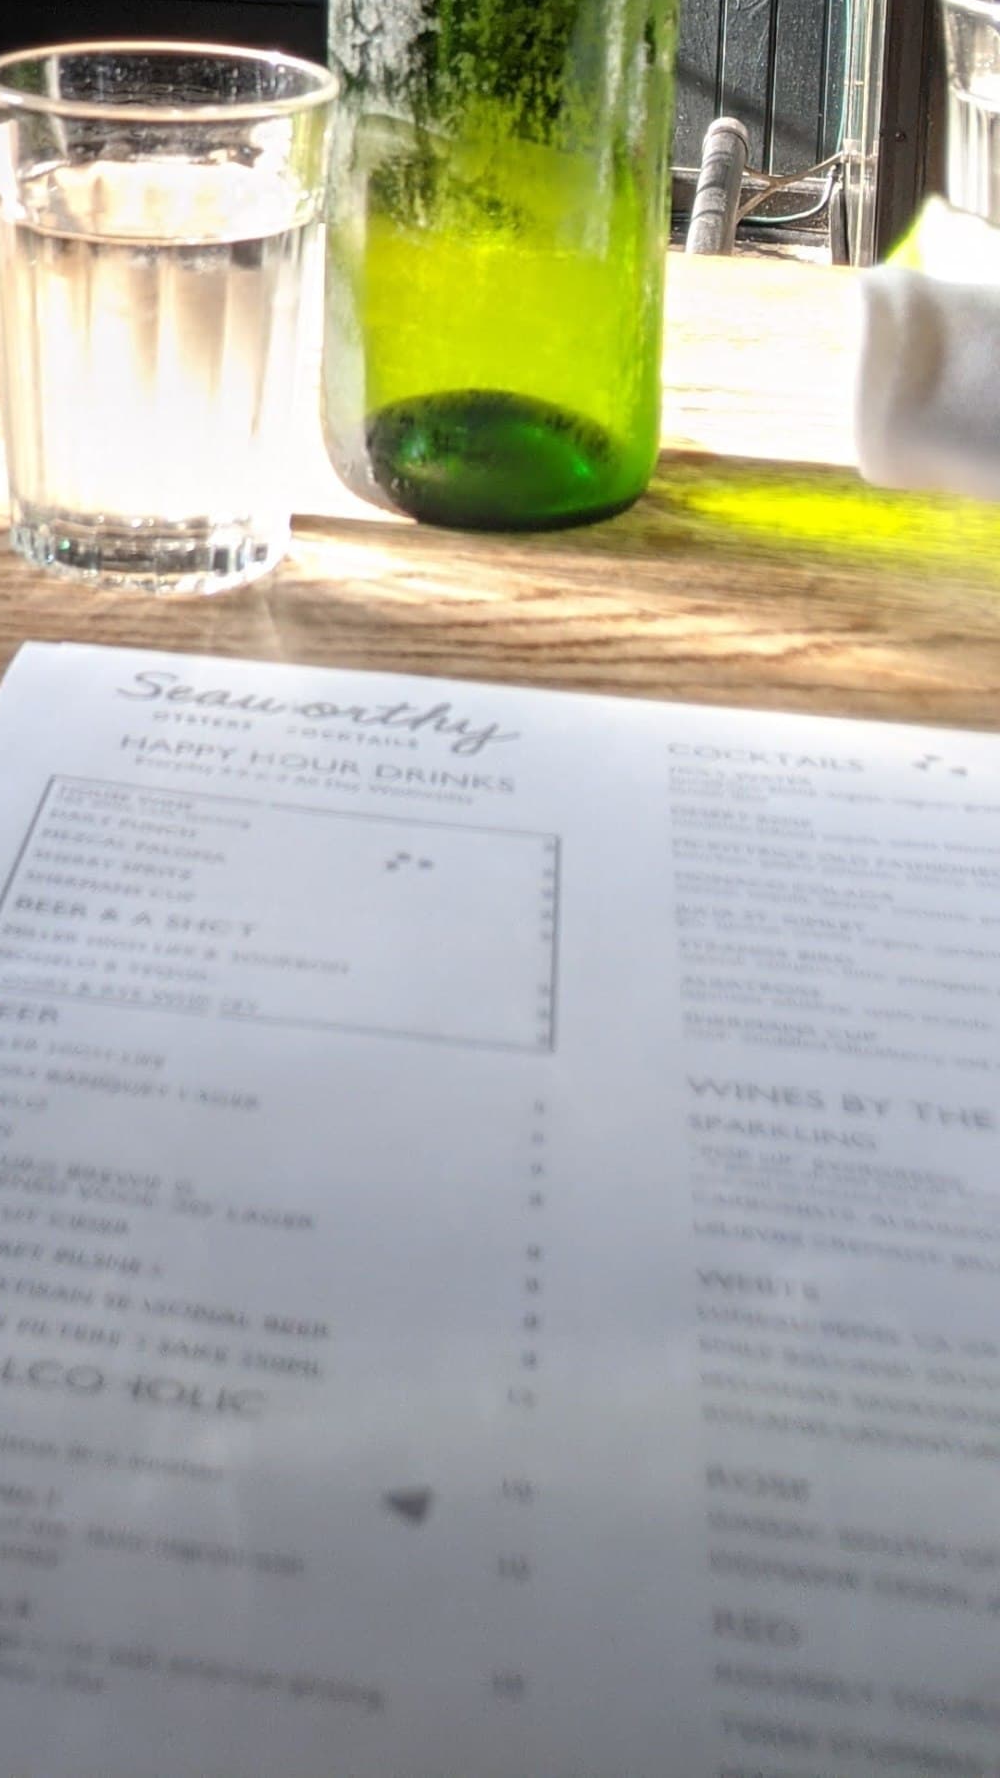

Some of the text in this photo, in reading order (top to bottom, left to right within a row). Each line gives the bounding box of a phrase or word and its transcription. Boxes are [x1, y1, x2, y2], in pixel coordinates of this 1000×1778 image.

[115, 671, 521, 757] Seaworthy
[119, 733, 239, 761] HAPPY
[250, 749, 360, 776] HOUR
[375, 763, 516, 794] DRINKS
[667, 741, 865, 773] COCKTAILS
[13, 892, 88, 918] BEER
[131, 909, 152, 927] A
[685, 1075, 997, 1133] WINES BY THE
[687, 1112, 878, 1152] SPARKLING
